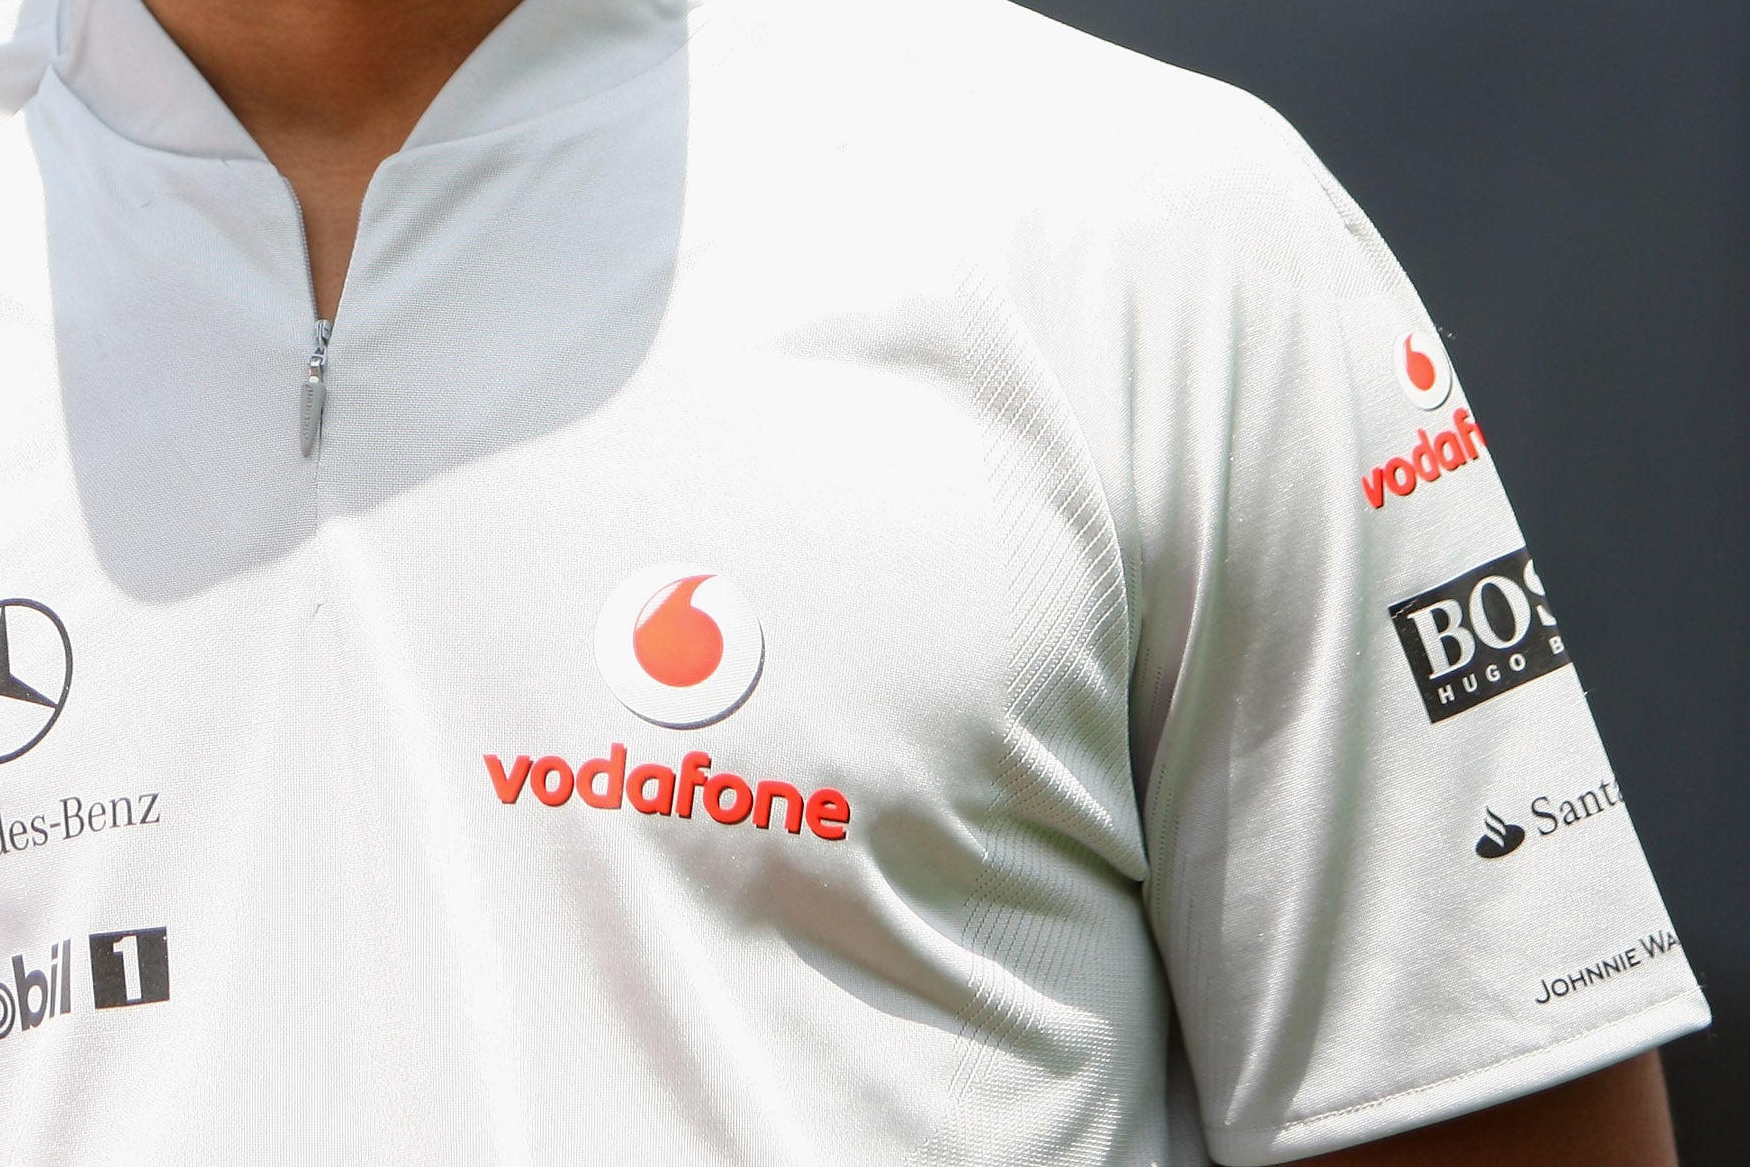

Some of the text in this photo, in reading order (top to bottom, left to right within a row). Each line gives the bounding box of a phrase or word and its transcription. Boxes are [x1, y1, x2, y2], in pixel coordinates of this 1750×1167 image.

[1437, 653, 1527, 705] HUGO
[483, 743, 851, 841] vodafone
[1536, 947, 1642, 1004] JOHNNIE
